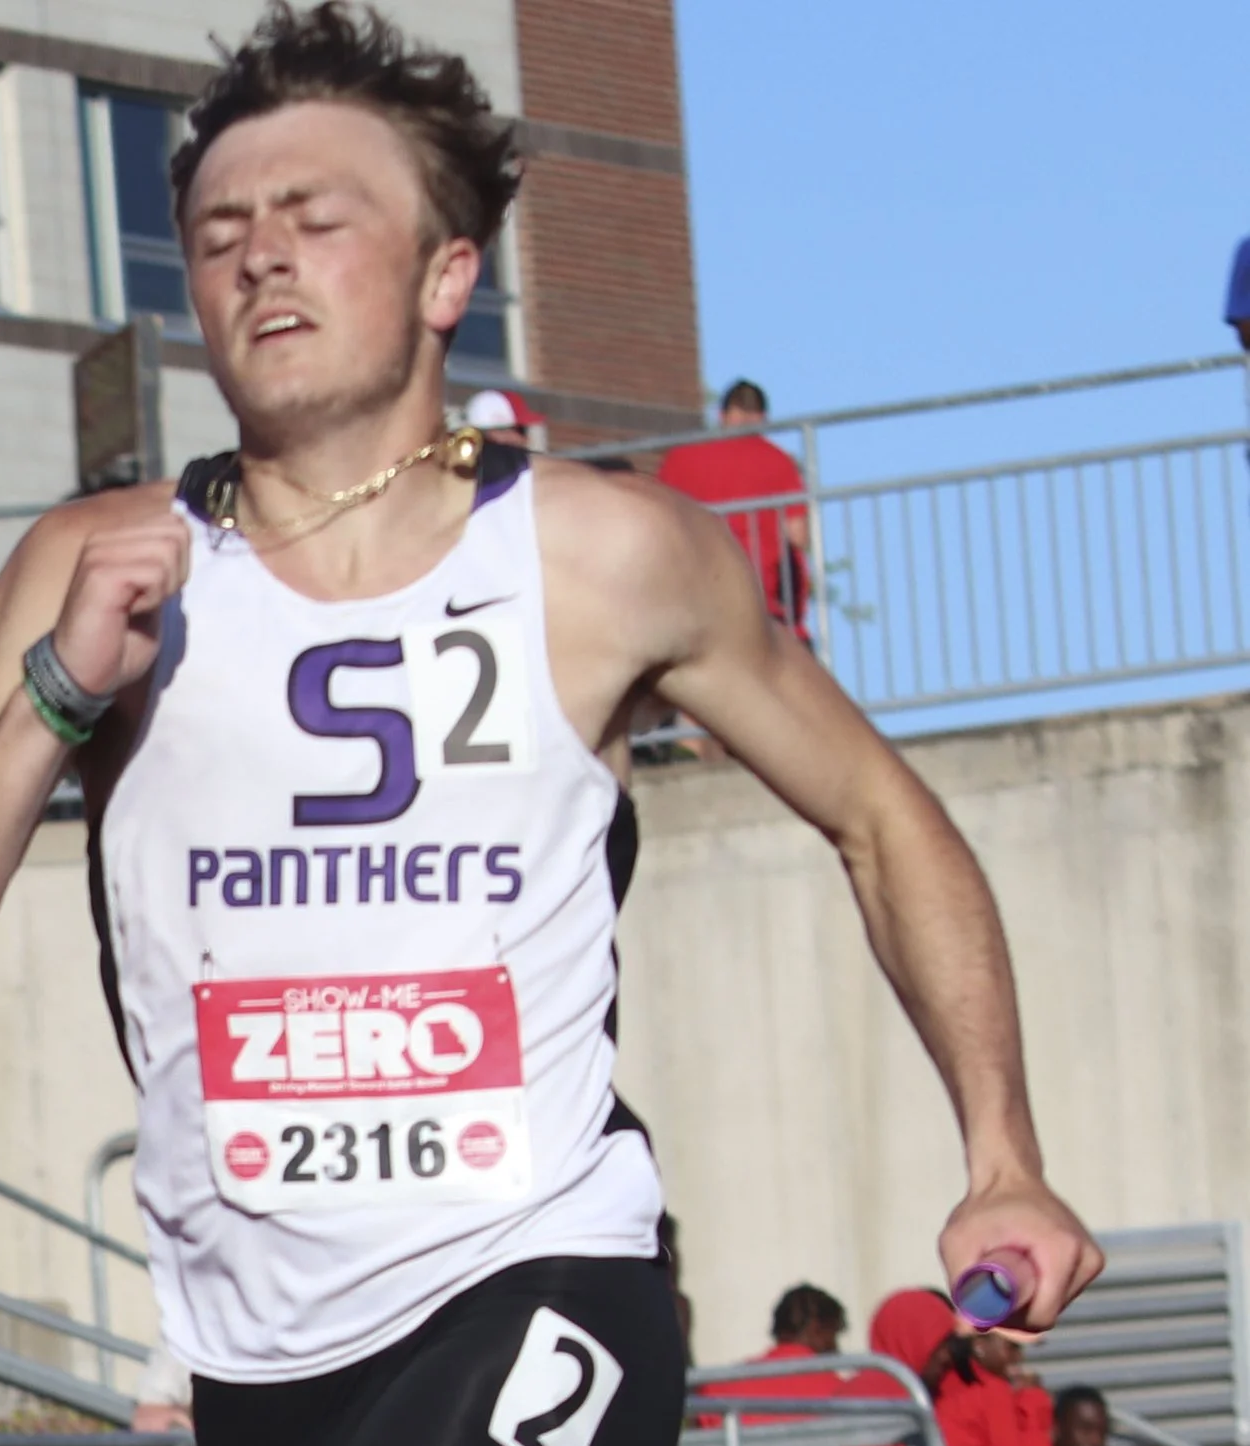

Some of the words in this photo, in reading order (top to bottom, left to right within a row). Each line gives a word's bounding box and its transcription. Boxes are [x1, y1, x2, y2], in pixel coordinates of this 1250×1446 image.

[288, 636, 422, 827] S
[433, 629, 510, 765] 2
[282, 982, 422, 1012] SHOW-ME
[226, 1002, 484, 1082] ZERO
[280, 1118, 447, 1183] 2316
